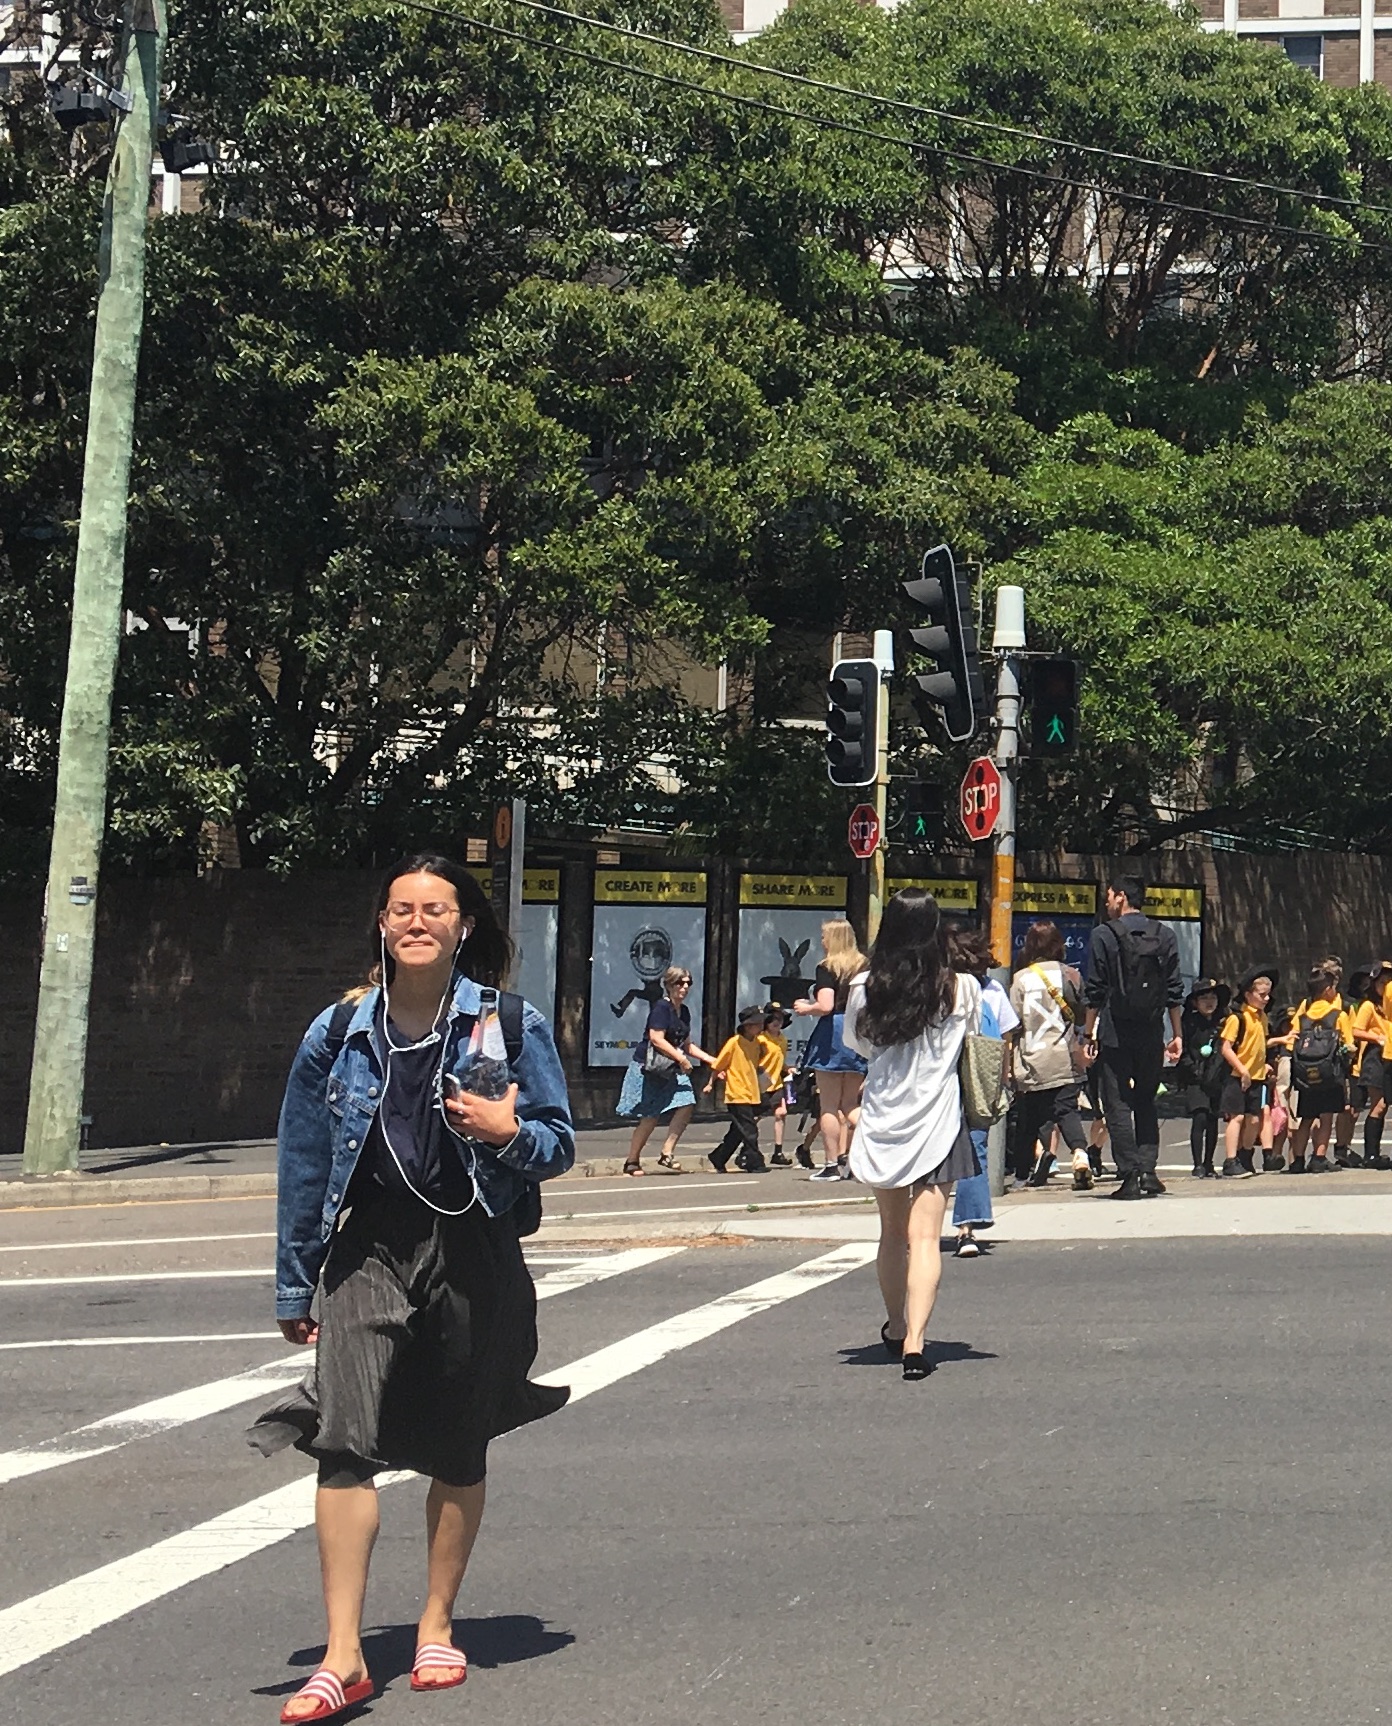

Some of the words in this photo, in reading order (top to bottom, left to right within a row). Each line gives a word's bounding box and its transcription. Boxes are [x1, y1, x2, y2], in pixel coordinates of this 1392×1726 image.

[964, 782, 998, 816] STOP
[605, 880, 653, 892] CREATE
[752, 884, 795, 896] SHARE
